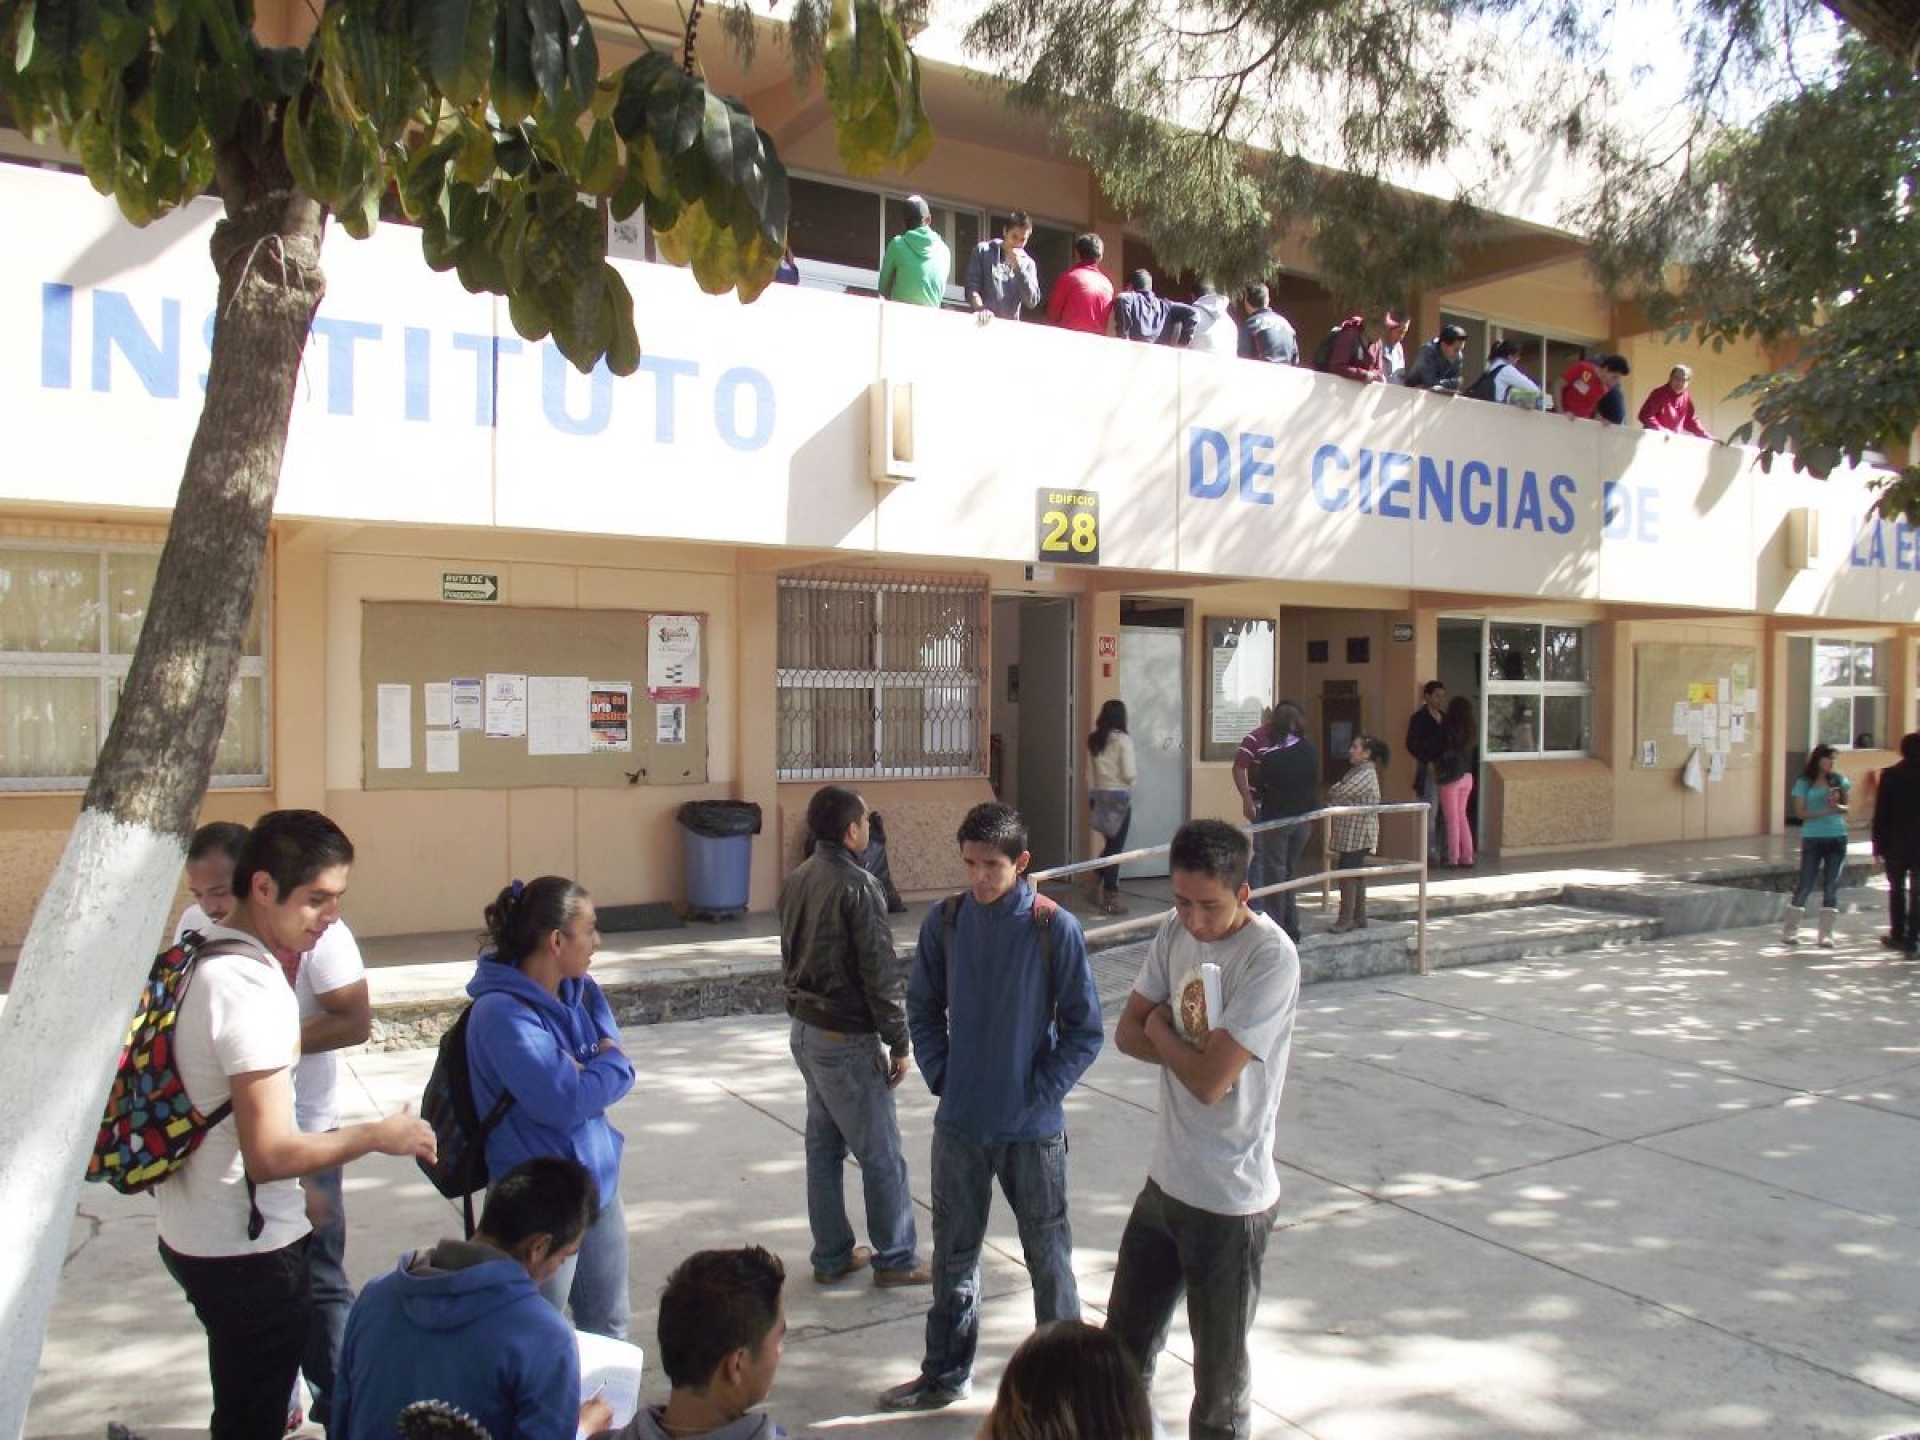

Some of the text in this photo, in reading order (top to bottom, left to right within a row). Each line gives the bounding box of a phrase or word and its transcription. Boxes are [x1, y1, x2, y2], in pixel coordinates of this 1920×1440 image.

[41, 282, 777, 452] INTITUTO
[1189, 427, 1275, 505] DE
[1311, 444, 1577, 534] CIENCIAS
[1602, 480, 1660, 543] DE
[1850, 512, 1886, 568] LA
[1049, 493, 1096, 506] EDIFICIO
[1042, 511, 1097, 553] 28
[446, 575, 485, 584] RUTA DE
